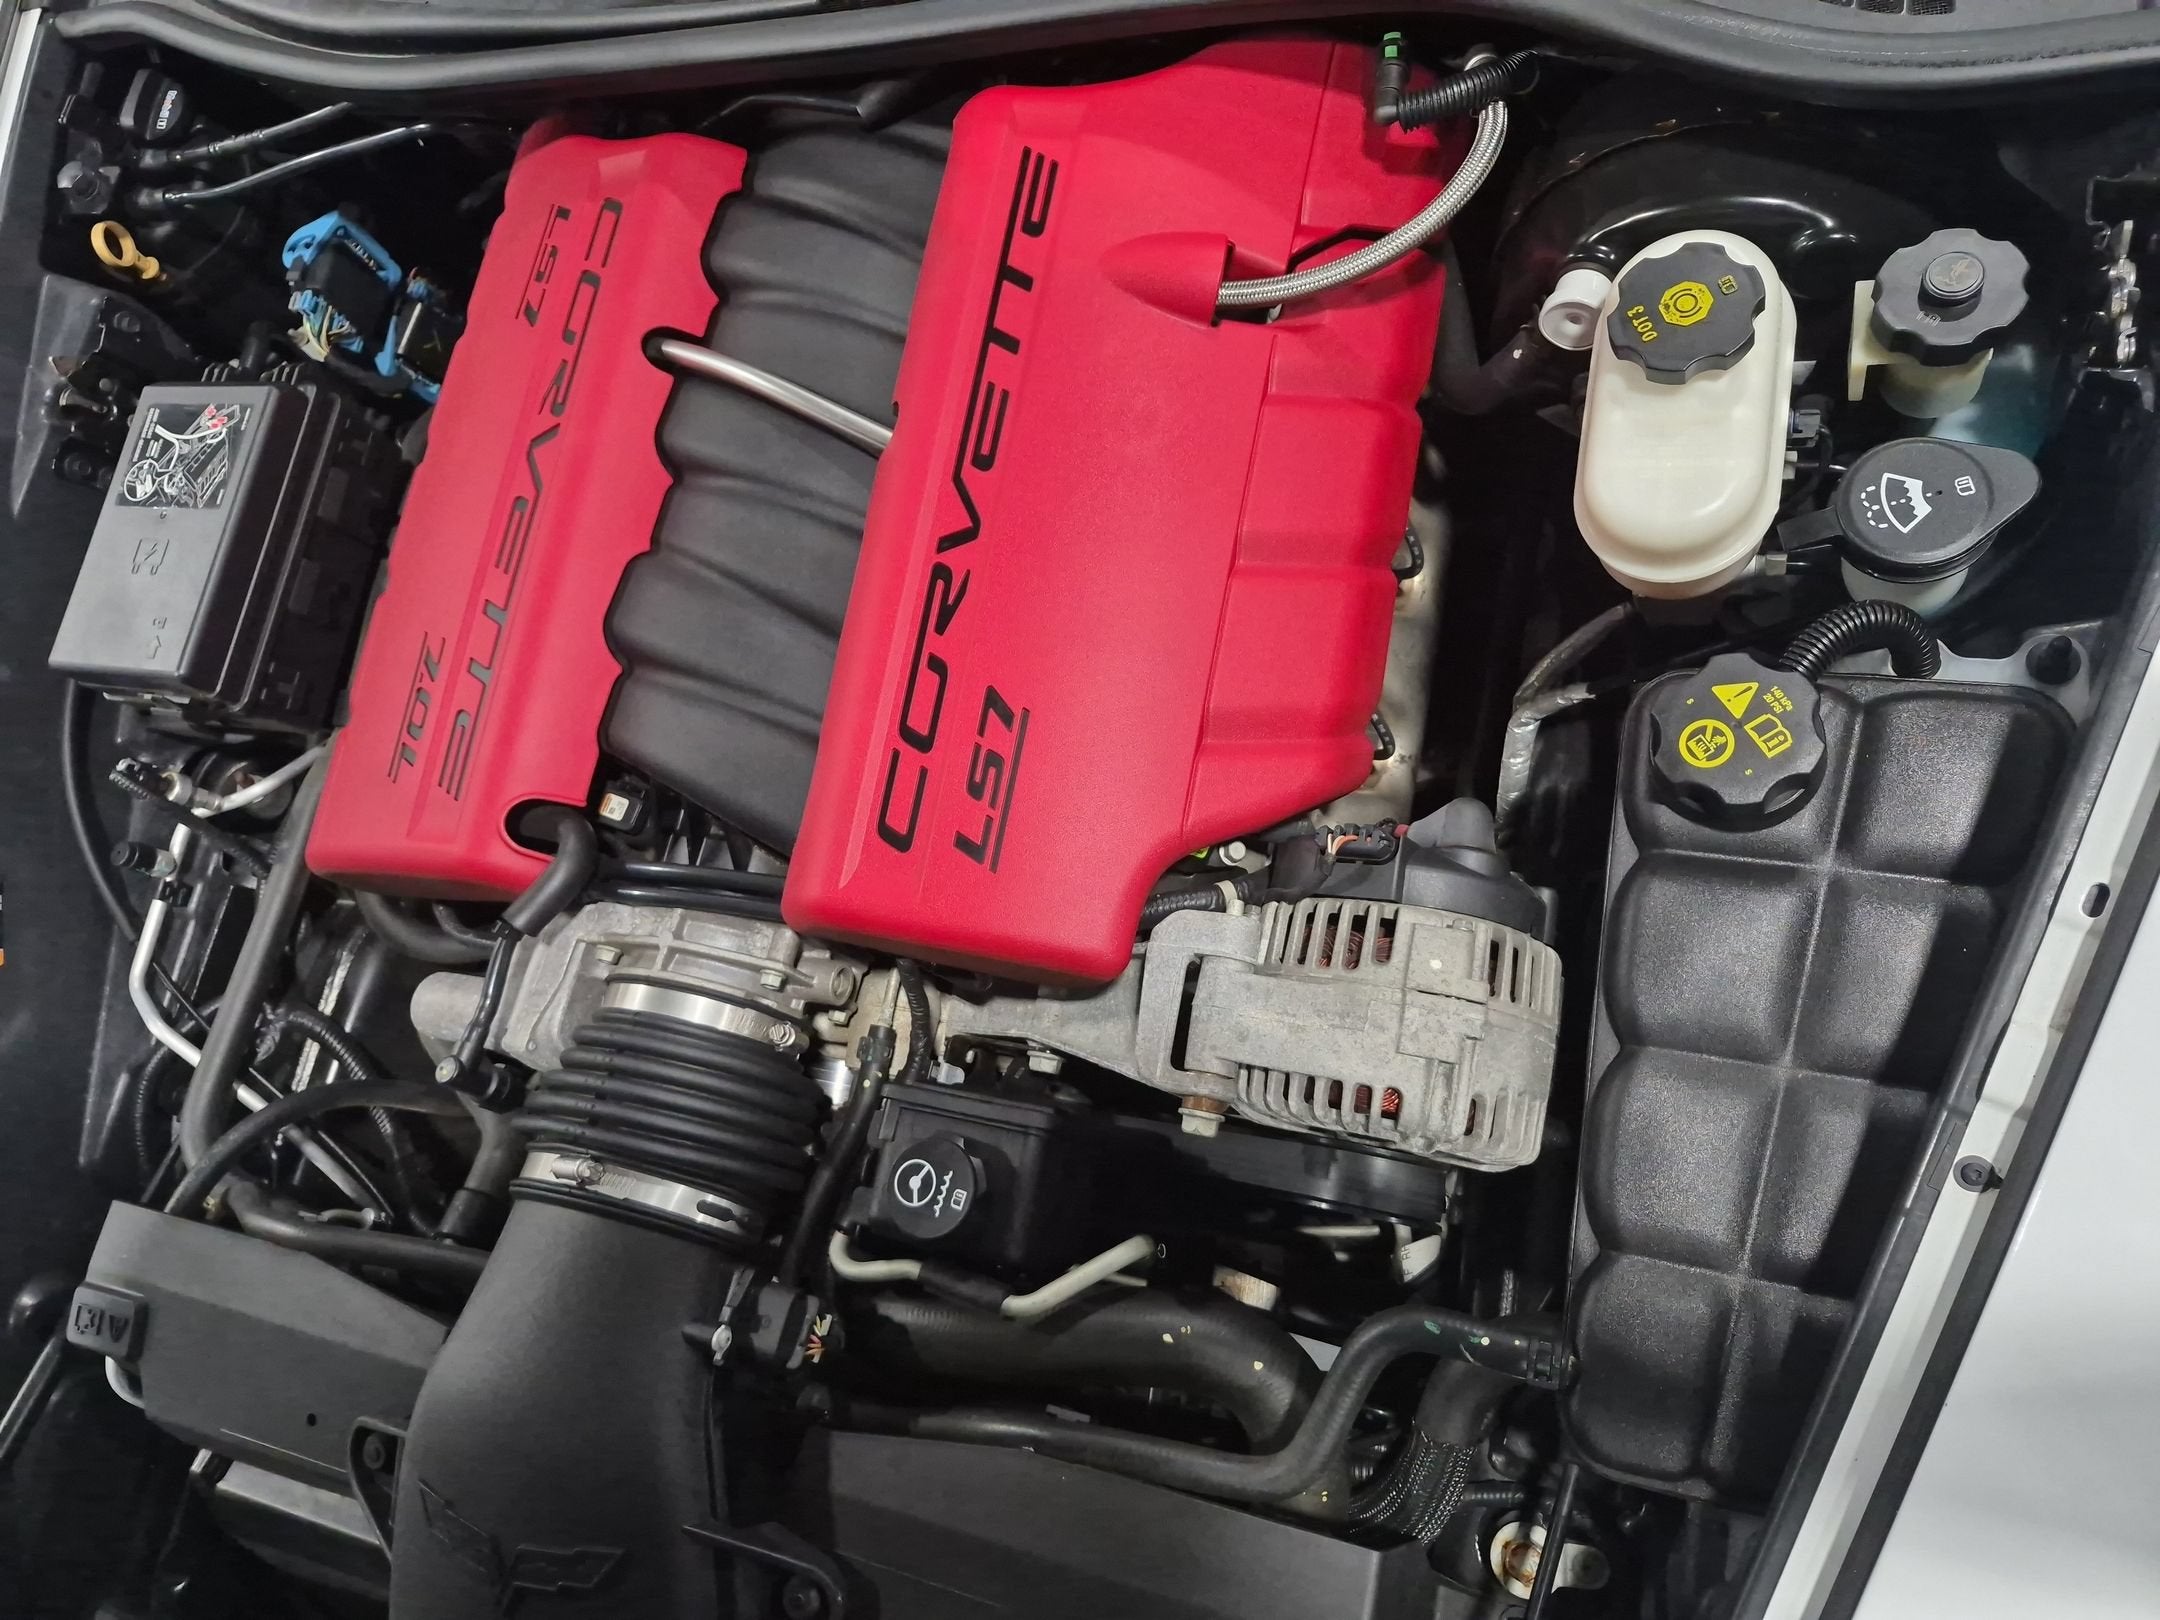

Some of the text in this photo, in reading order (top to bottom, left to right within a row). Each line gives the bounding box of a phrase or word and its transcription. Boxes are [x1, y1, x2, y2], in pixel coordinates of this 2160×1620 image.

[516, 203, 571, 327] LS7
[438, 197, 623, 802] CORVETTE
[875, 145, 1059, 854] CORVETTE
[1762, 693, 1784, 714] 20 PSI
[1770, 685, 1784, 699] 140
[953, 683, 1031, 876] LS7
